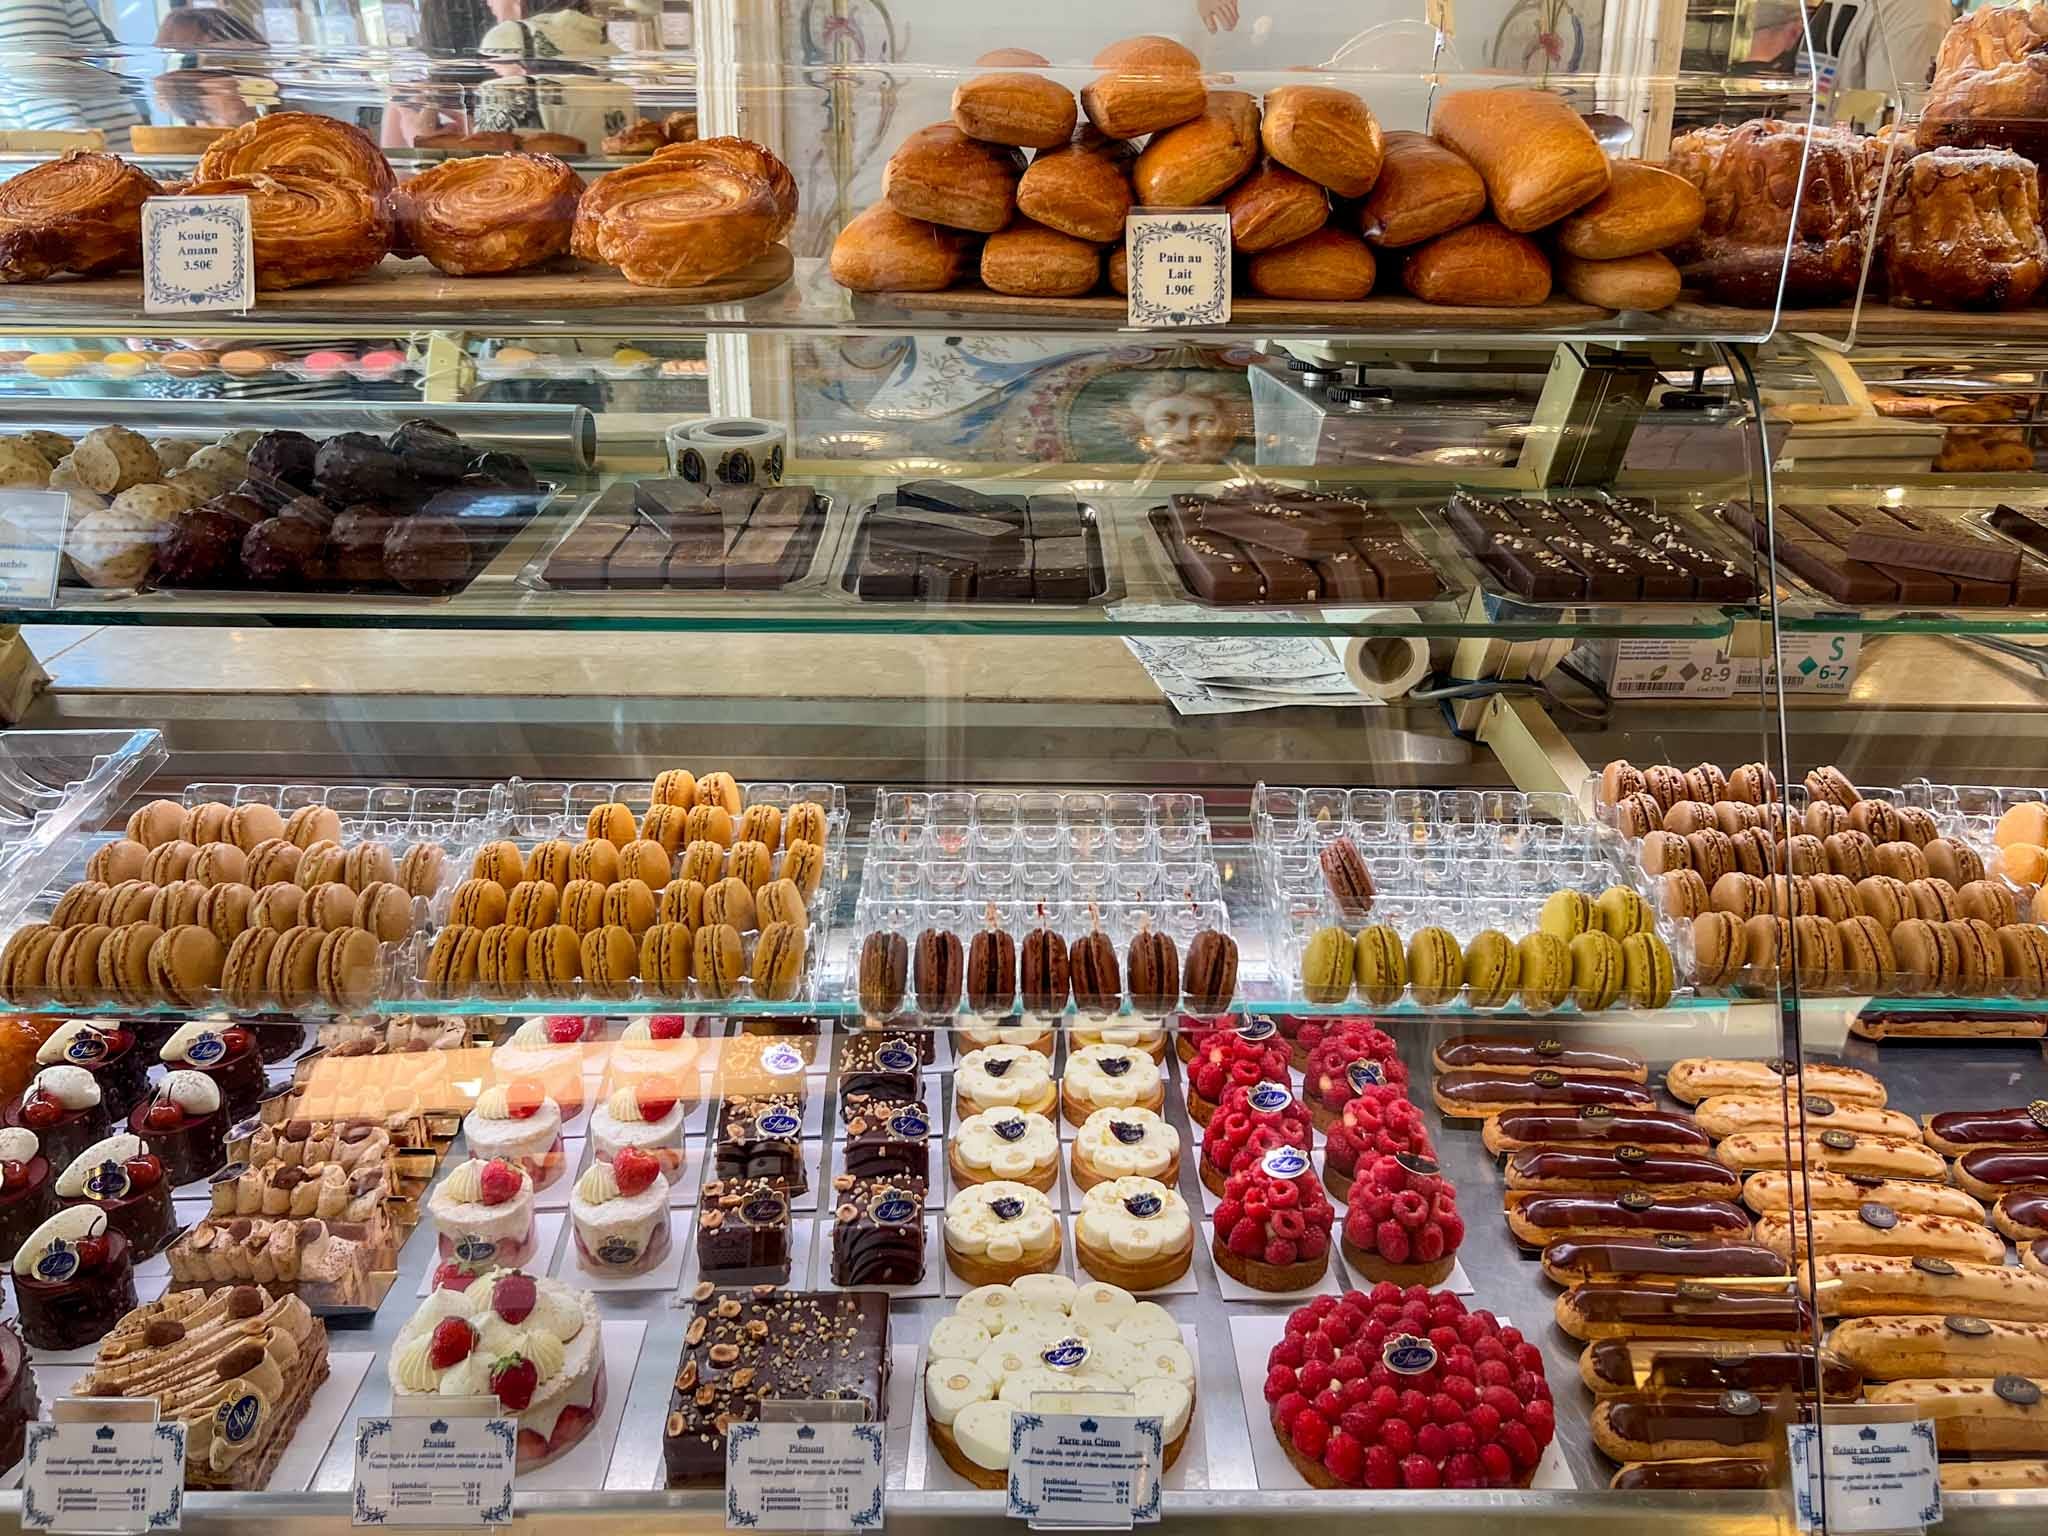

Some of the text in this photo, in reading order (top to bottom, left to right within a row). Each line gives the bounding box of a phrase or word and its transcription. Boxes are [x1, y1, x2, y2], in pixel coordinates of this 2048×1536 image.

[178, 231, 218, 242] Kouign
[178, 246, 218, 256] Amann
[1159, 252, 1202, 263] Pain au
[183, 260, 213, 271] 3.50€
[1168, 268, 1192, 279] Lait
[1165, 284, 1194, 295] 1.90€
[1828, 636, 1845, 661] S
[1701, 667, 1731, 681] 8-9
[1819, 665, 1849, 681] 6-7
[1057, 1436, 1081, 1446] Tarte
[1094, 1438, 1121, 1448] Citron
